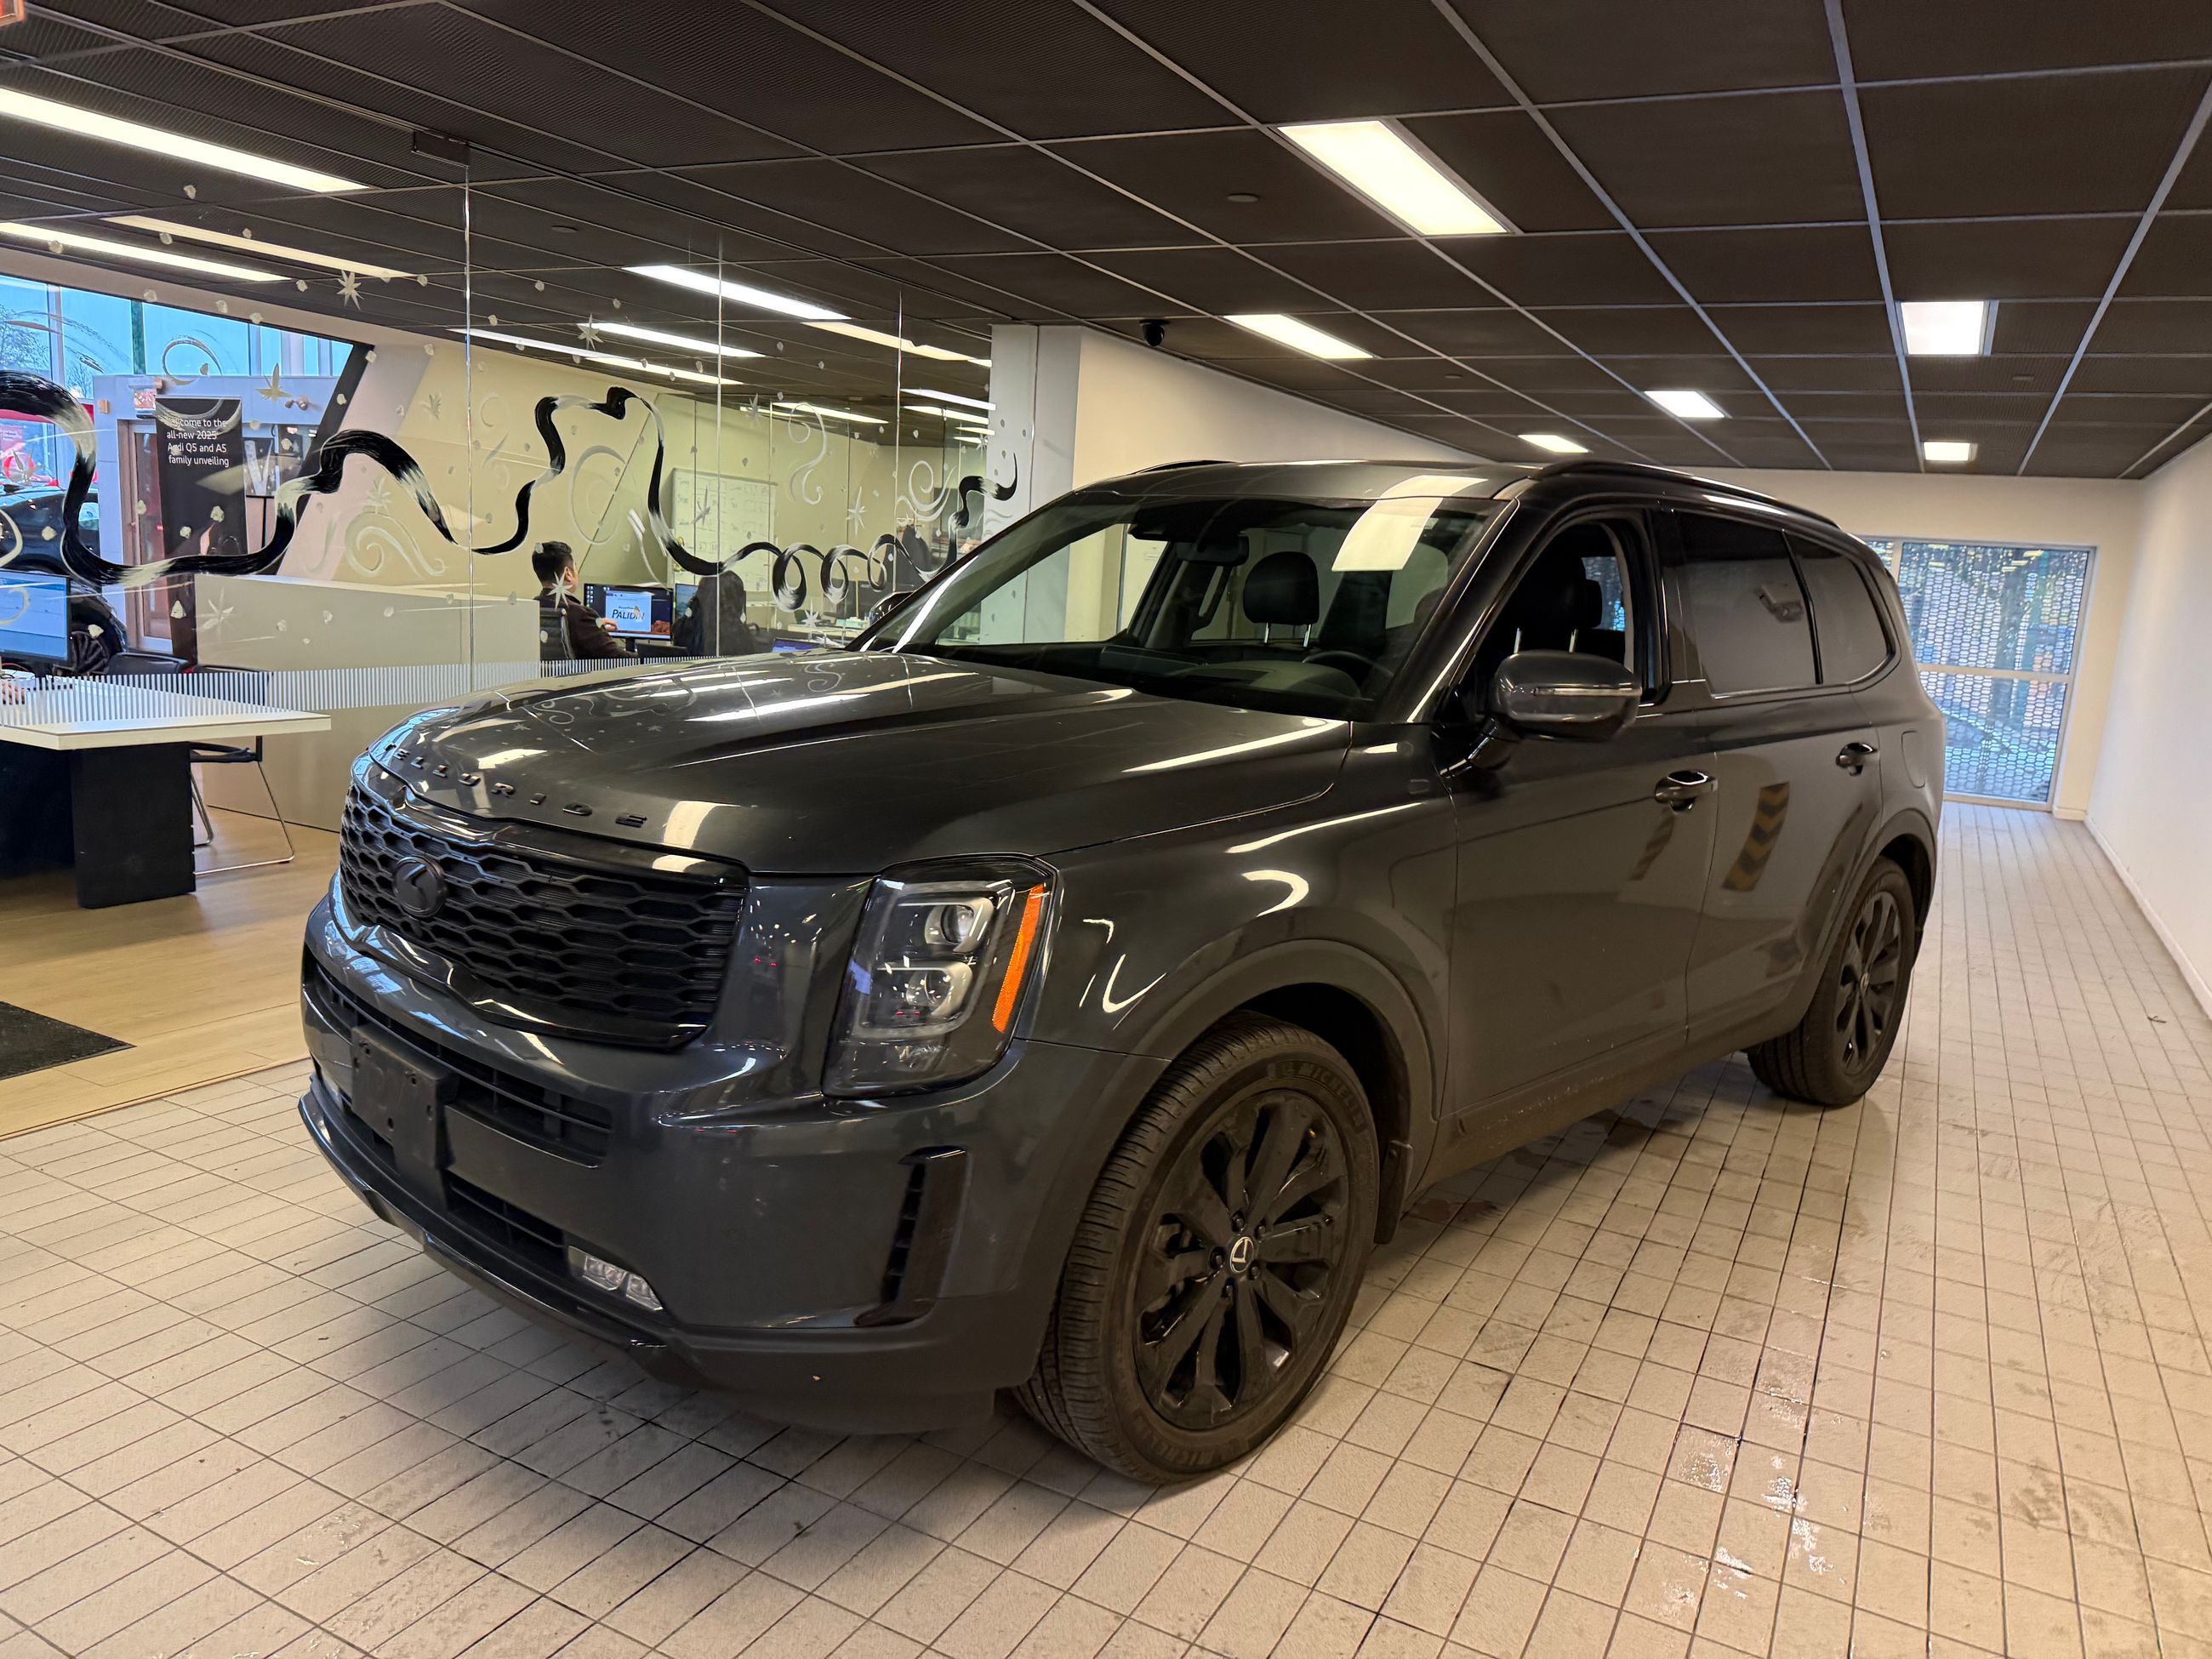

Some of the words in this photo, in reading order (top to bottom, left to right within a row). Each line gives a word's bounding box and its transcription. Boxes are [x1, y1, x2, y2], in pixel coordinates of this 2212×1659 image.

[203, 419, 212, 427] to
[214, 418, 226, 427] the
[167, 430, 195, 439] all-new
[197, 430, 218, 440] 2025
[168, 442, 185, 452] Adi
[185, 442, 197, 453] Q5
[199, 443, 214, 453] and
[215, 444, 227, 453] A5
[168, 454, 192, 466] family
[193, 455, 230, 468] unveiling
[385, 742, 647, 829] TELLURIDE
